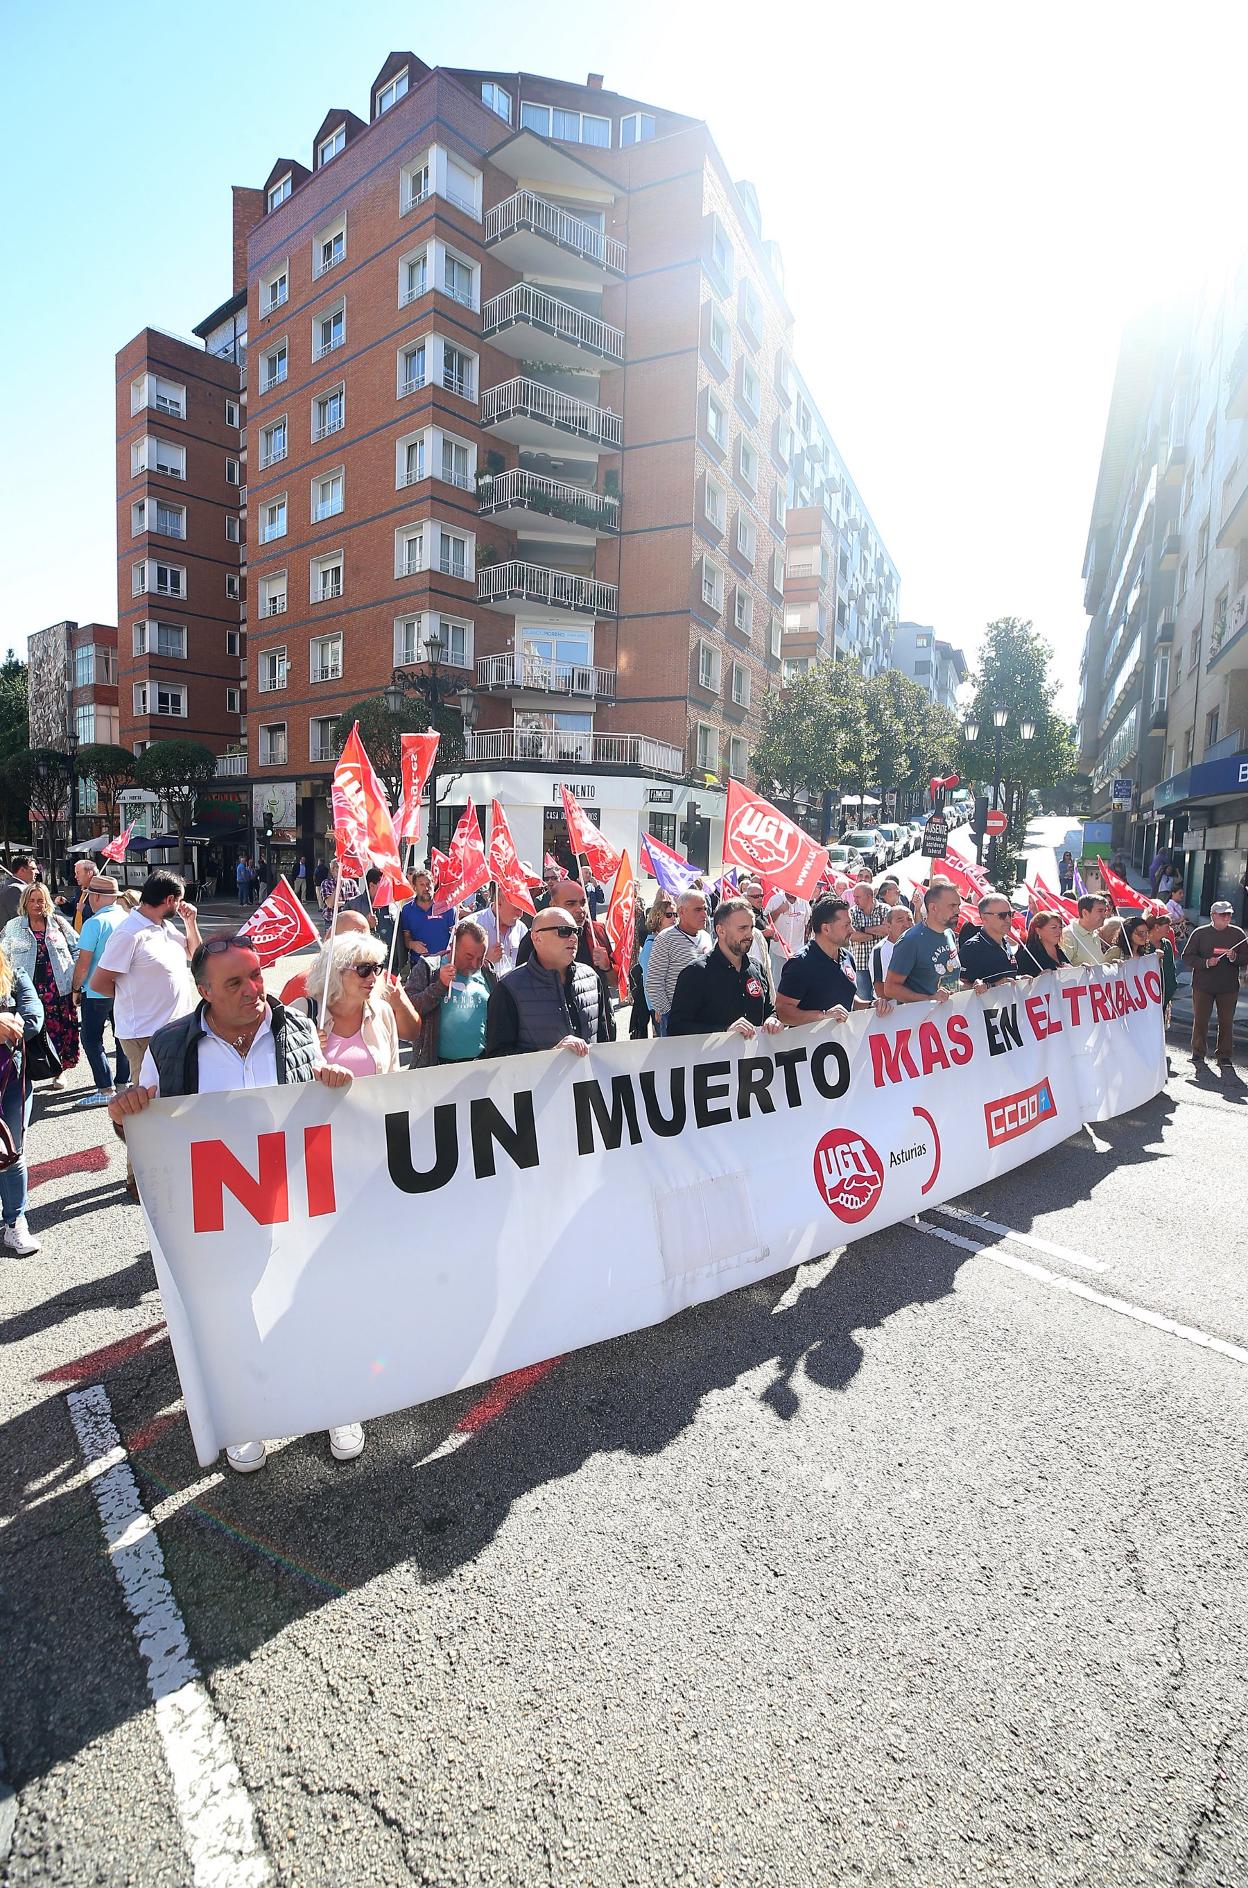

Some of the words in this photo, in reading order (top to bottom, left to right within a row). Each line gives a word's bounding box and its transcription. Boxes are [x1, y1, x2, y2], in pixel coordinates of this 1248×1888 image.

[739, 806, 796, 851] UGT
[190, 1124, 337, 1234] NI
[384, 1090, 541, 1195] UN
[573, 1041, 851, 1156] MUERTO
[868, 1014, 974, 1088] MAS
[983, 1003, 1024, 1057] EN
[1024, 993, 1063, 1041] EL
[1062, 969, 1162, 1027] TRABAJO
[989, 1094, 1038, 1138] CCOO
[818, 1139, 880, 1178] UGT
[889, 1142, 927, 1169] Asturias
